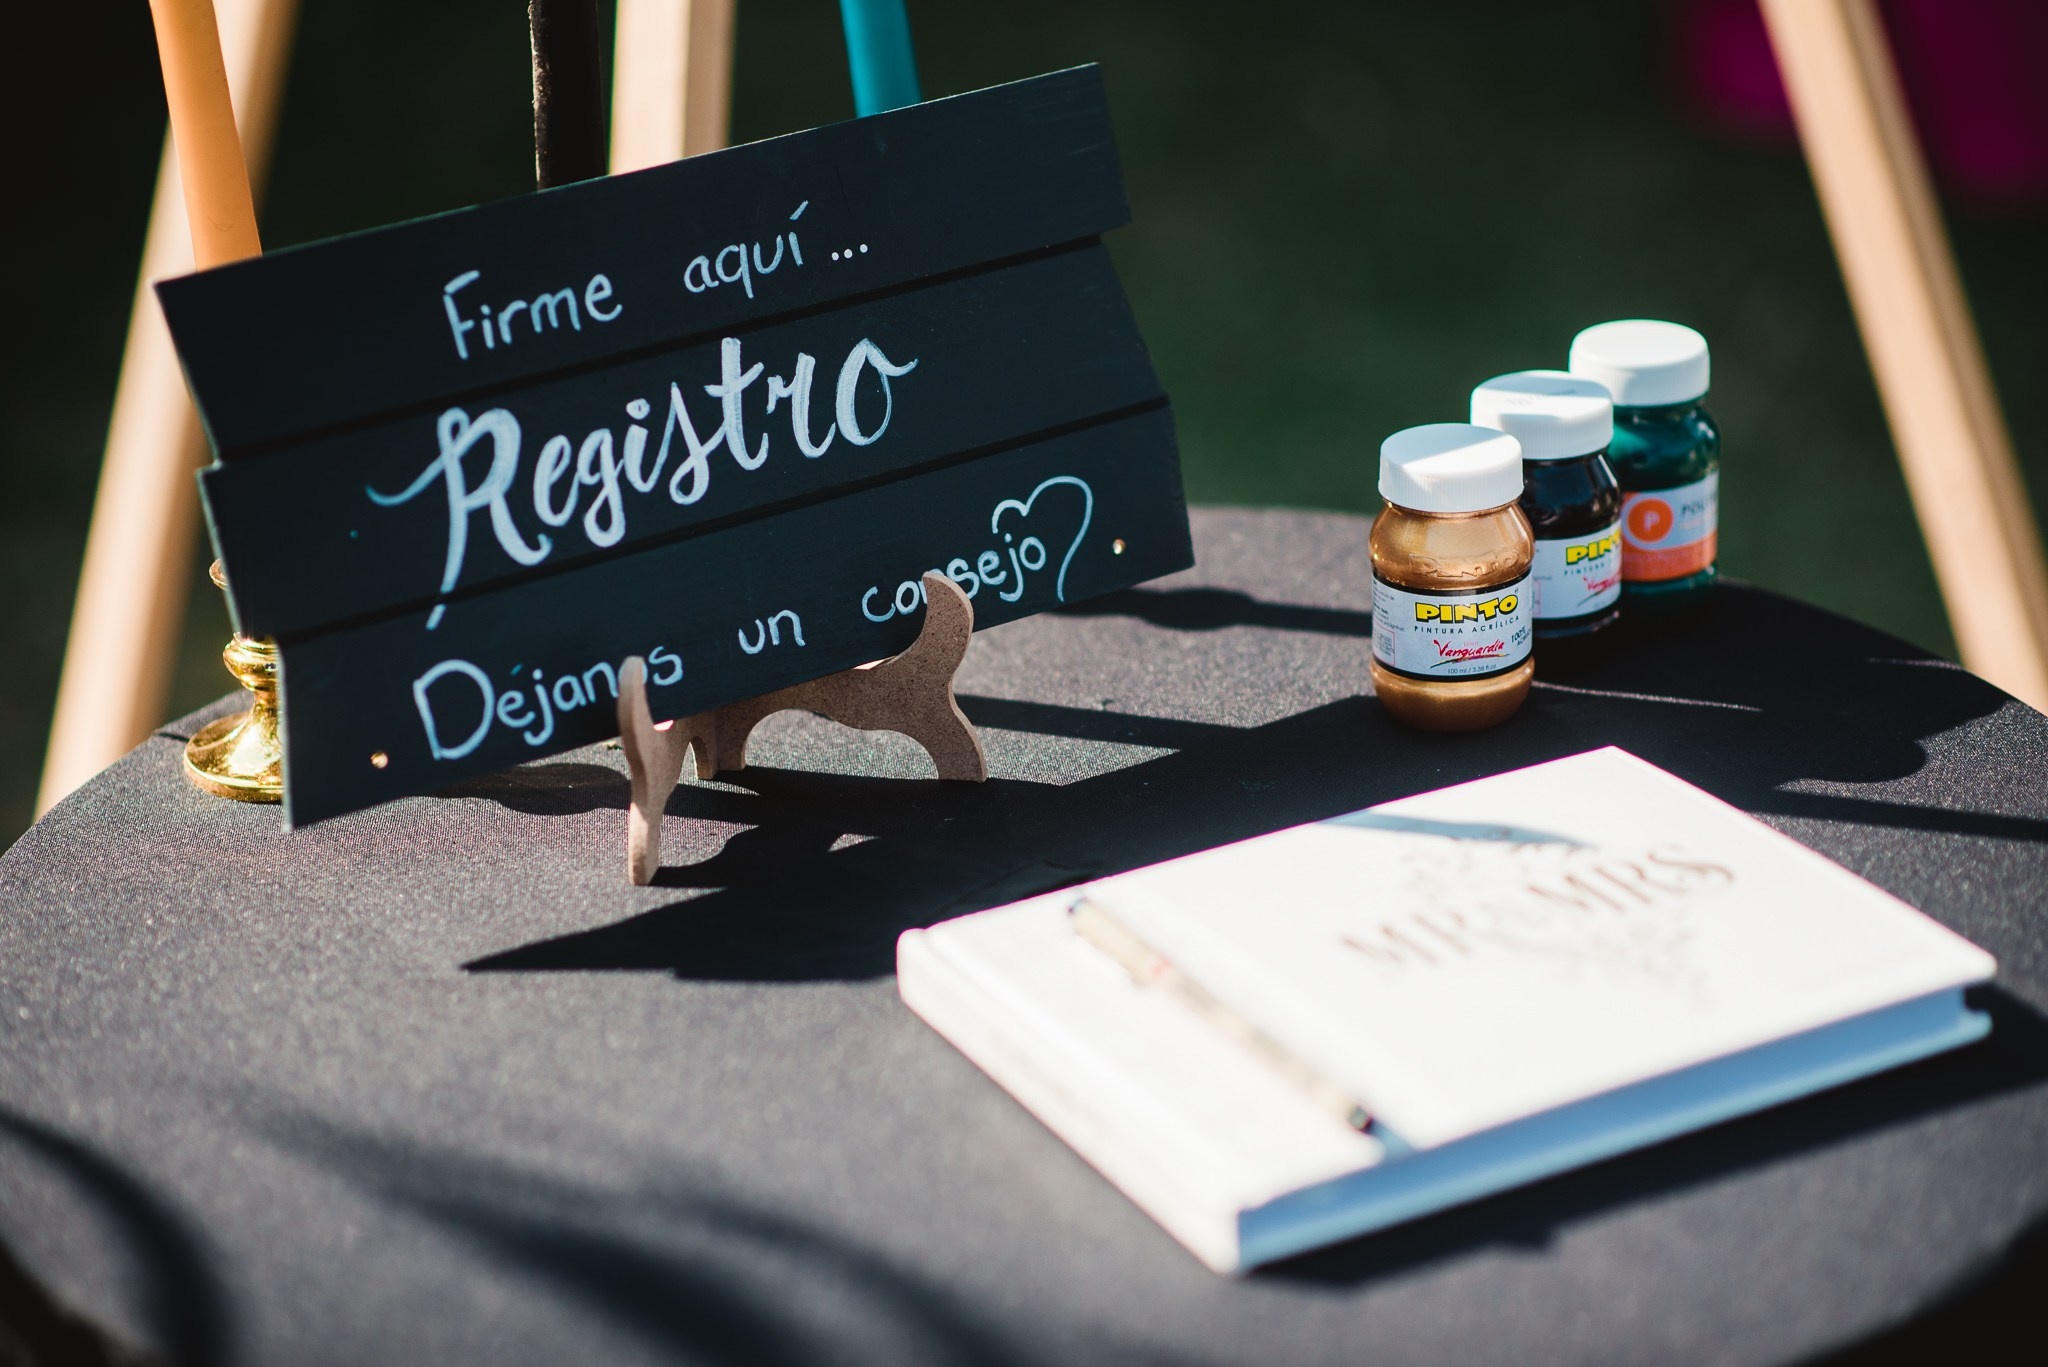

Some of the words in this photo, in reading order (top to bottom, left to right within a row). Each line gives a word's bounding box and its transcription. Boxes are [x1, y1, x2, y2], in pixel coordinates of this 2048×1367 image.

[443, 270, 622, 359] Firme
[366, 337, 918, 630] Registro
[1414, 594, 1519, 624] PINTO
[1414, 625, 1464, 635] PINTURA
[1472, 615, 1520, 633] ACRÍLICA
[738, 610, 806, 654] un
[1433, 638, 1505, 659] Vanguardia
